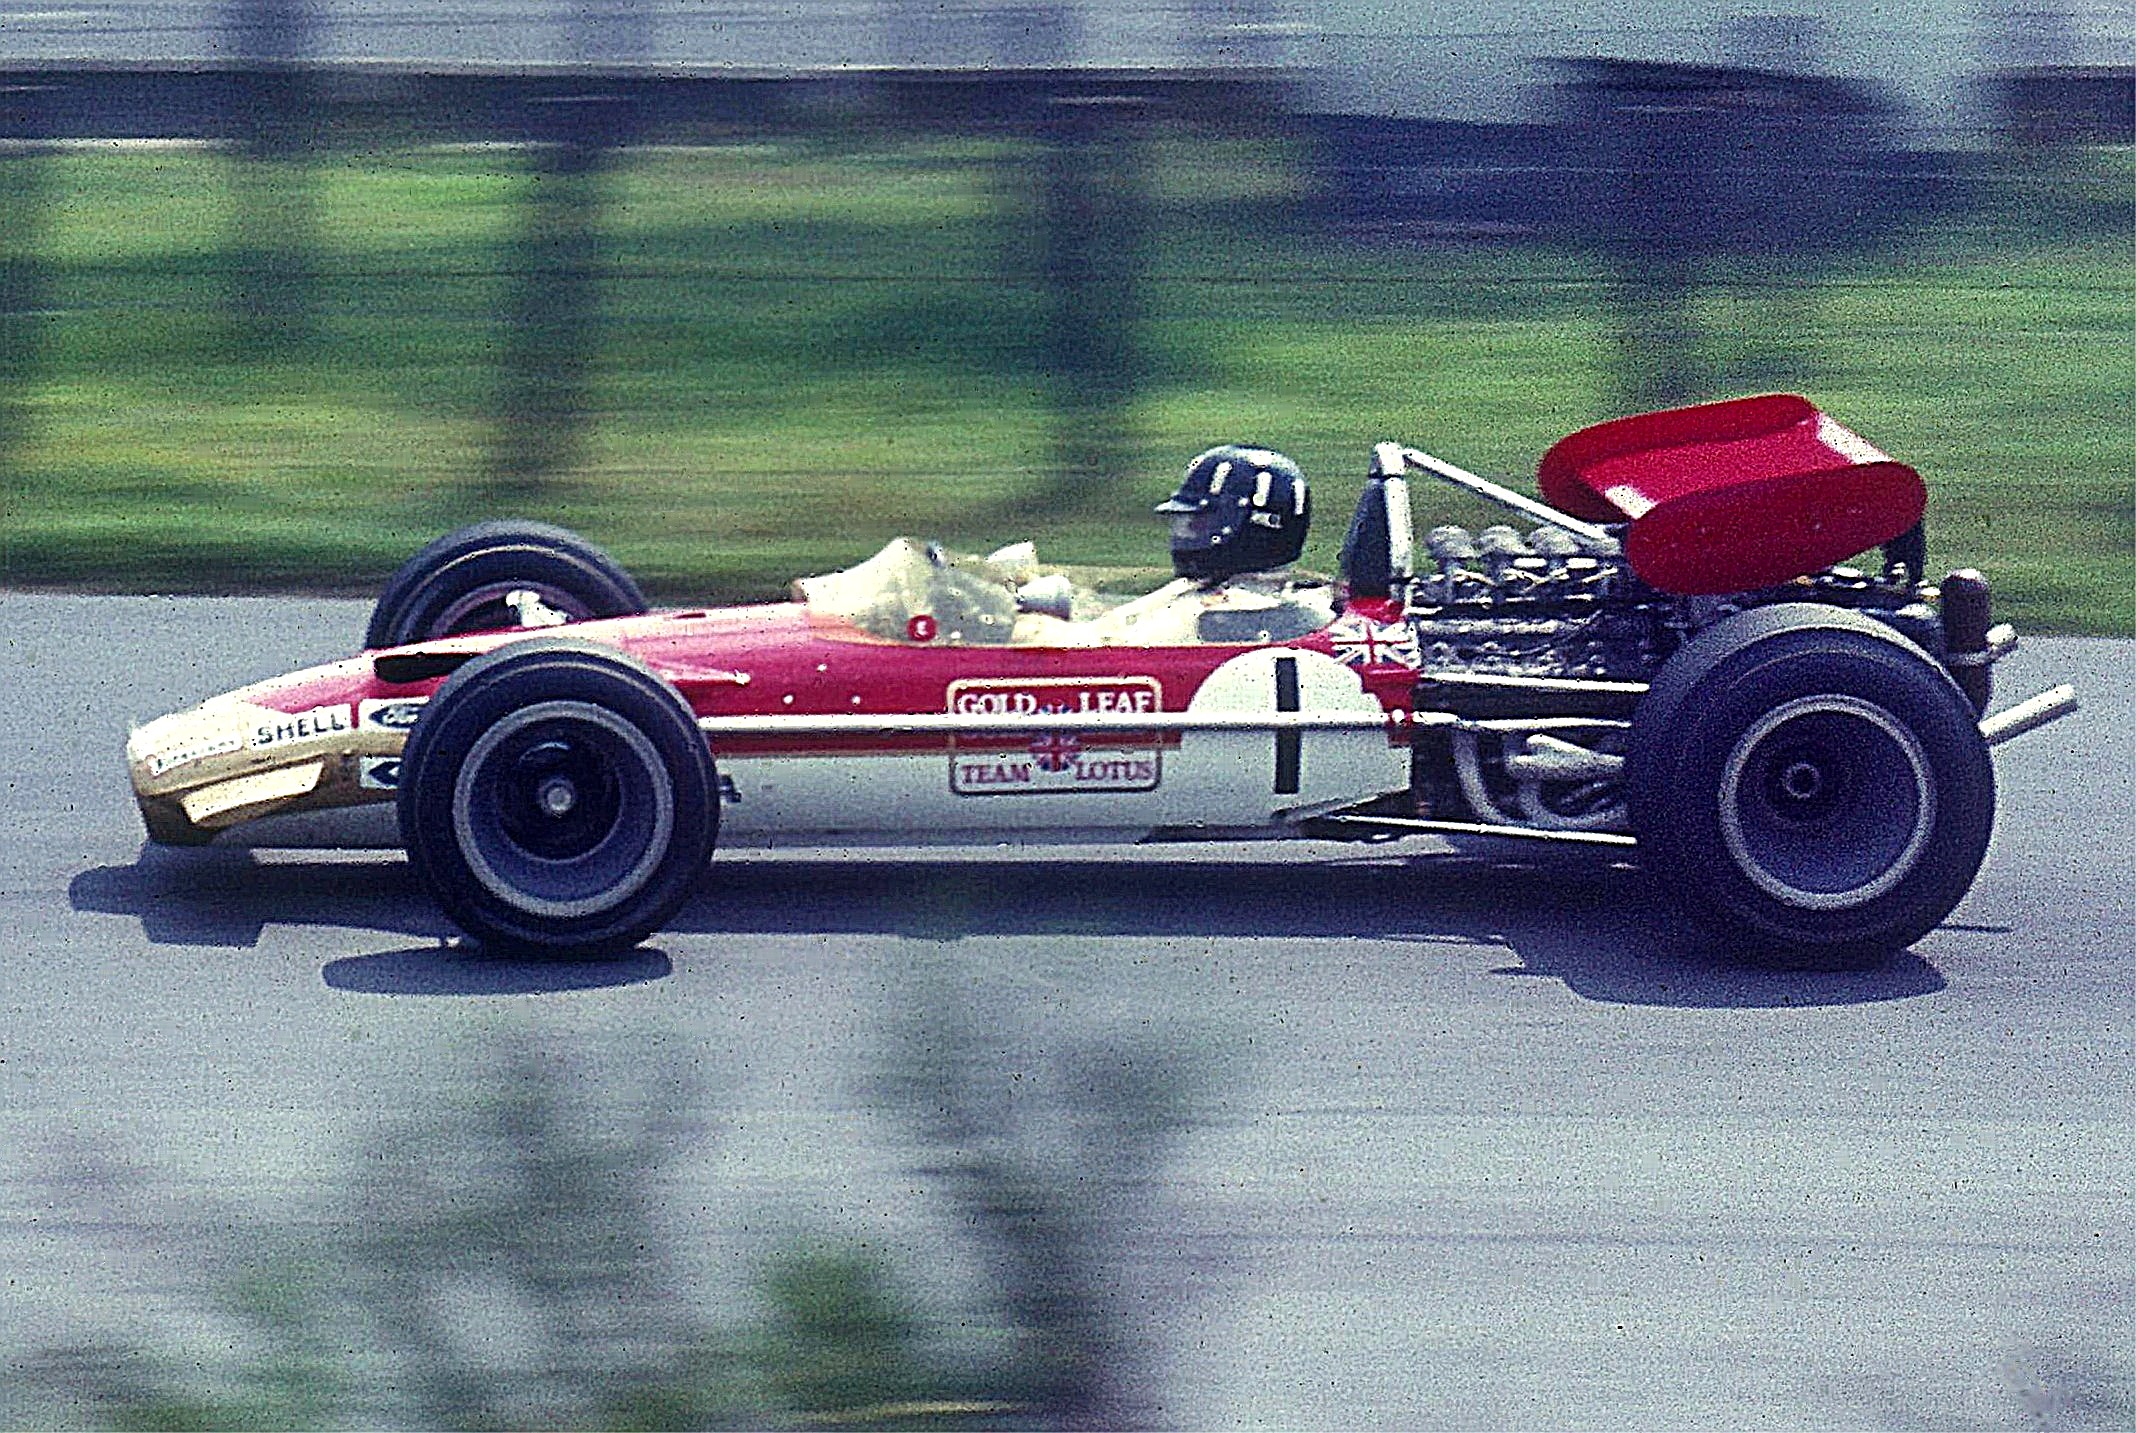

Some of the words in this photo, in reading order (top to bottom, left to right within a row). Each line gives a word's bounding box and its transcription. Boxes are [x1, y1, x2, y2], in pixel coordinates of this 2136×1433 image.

[958, 692, 1037, 715] GOLD
[1077, 691, 1153, 714] LEAF
[257, 712, 345, 744] SHELL
[961, 764, 1030, 784] TEAM
[1075, 761, 1152, 781] LOTUS
